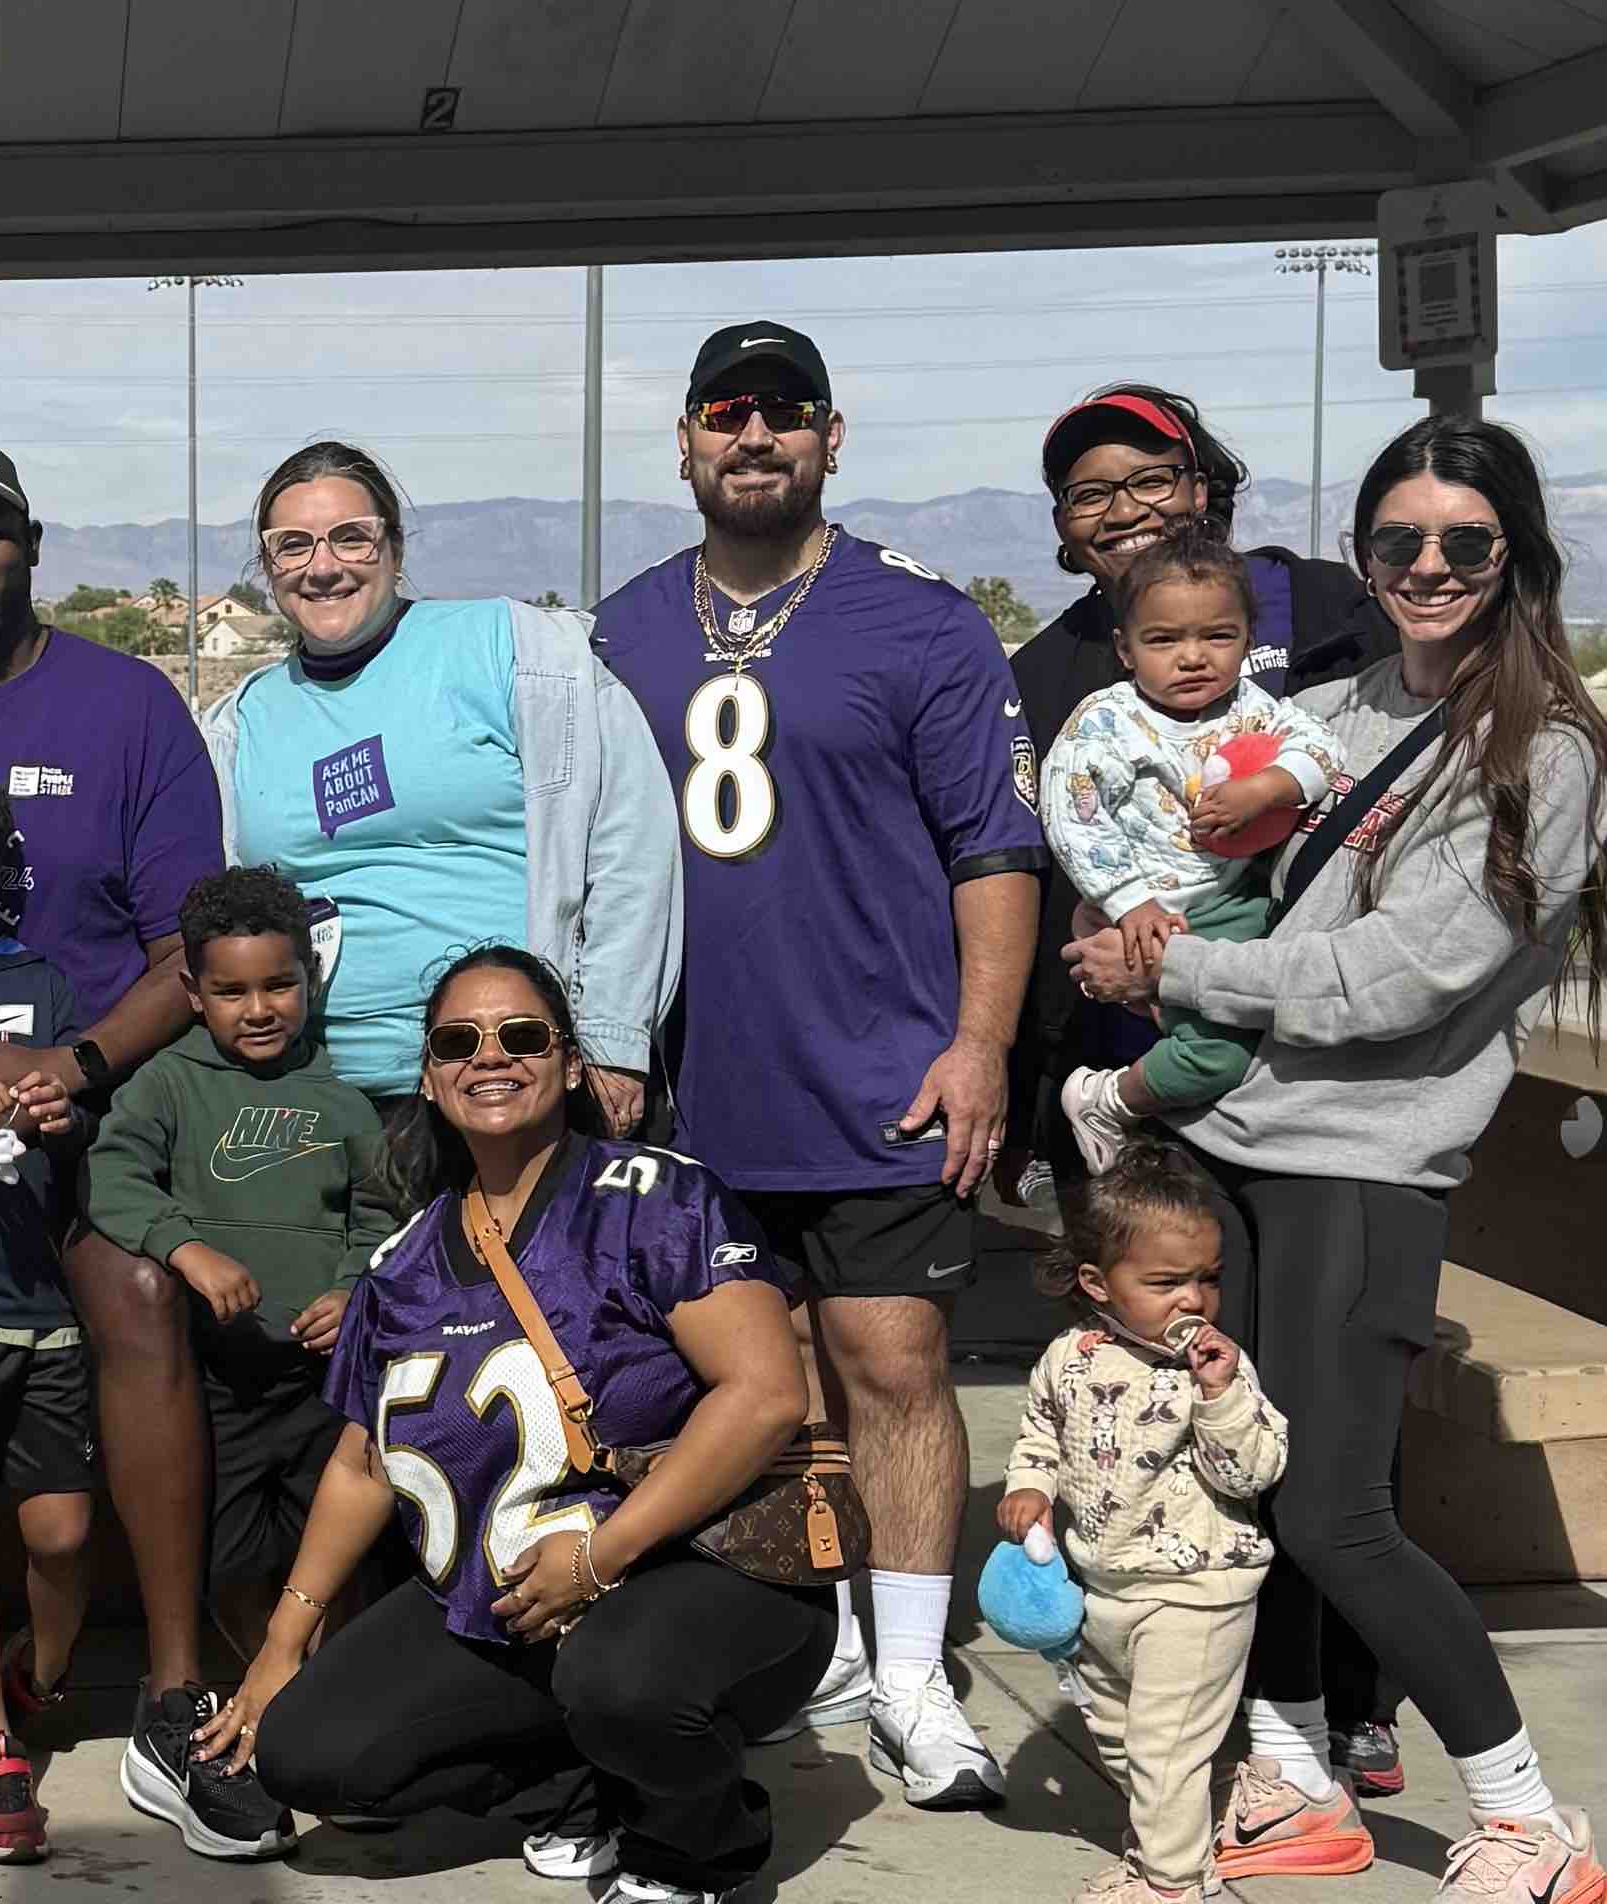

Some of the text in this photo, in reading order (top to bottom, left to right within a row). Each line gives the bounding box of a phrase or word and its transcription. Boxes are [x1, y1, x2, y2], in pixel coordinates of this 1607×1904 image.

[423, 91, 456, 129] 2
[879, 548, 941, 581] 8
[322, 747, 371, 781] ASK ME
[324, 764, 374, 798] ABOUT
[683, 673, 776, 858] 8
[325, 783, 380, 817] PanCAN
[225, 1106, 320, 1151] NIKE
[377, 1338, 597, 1588] 52
